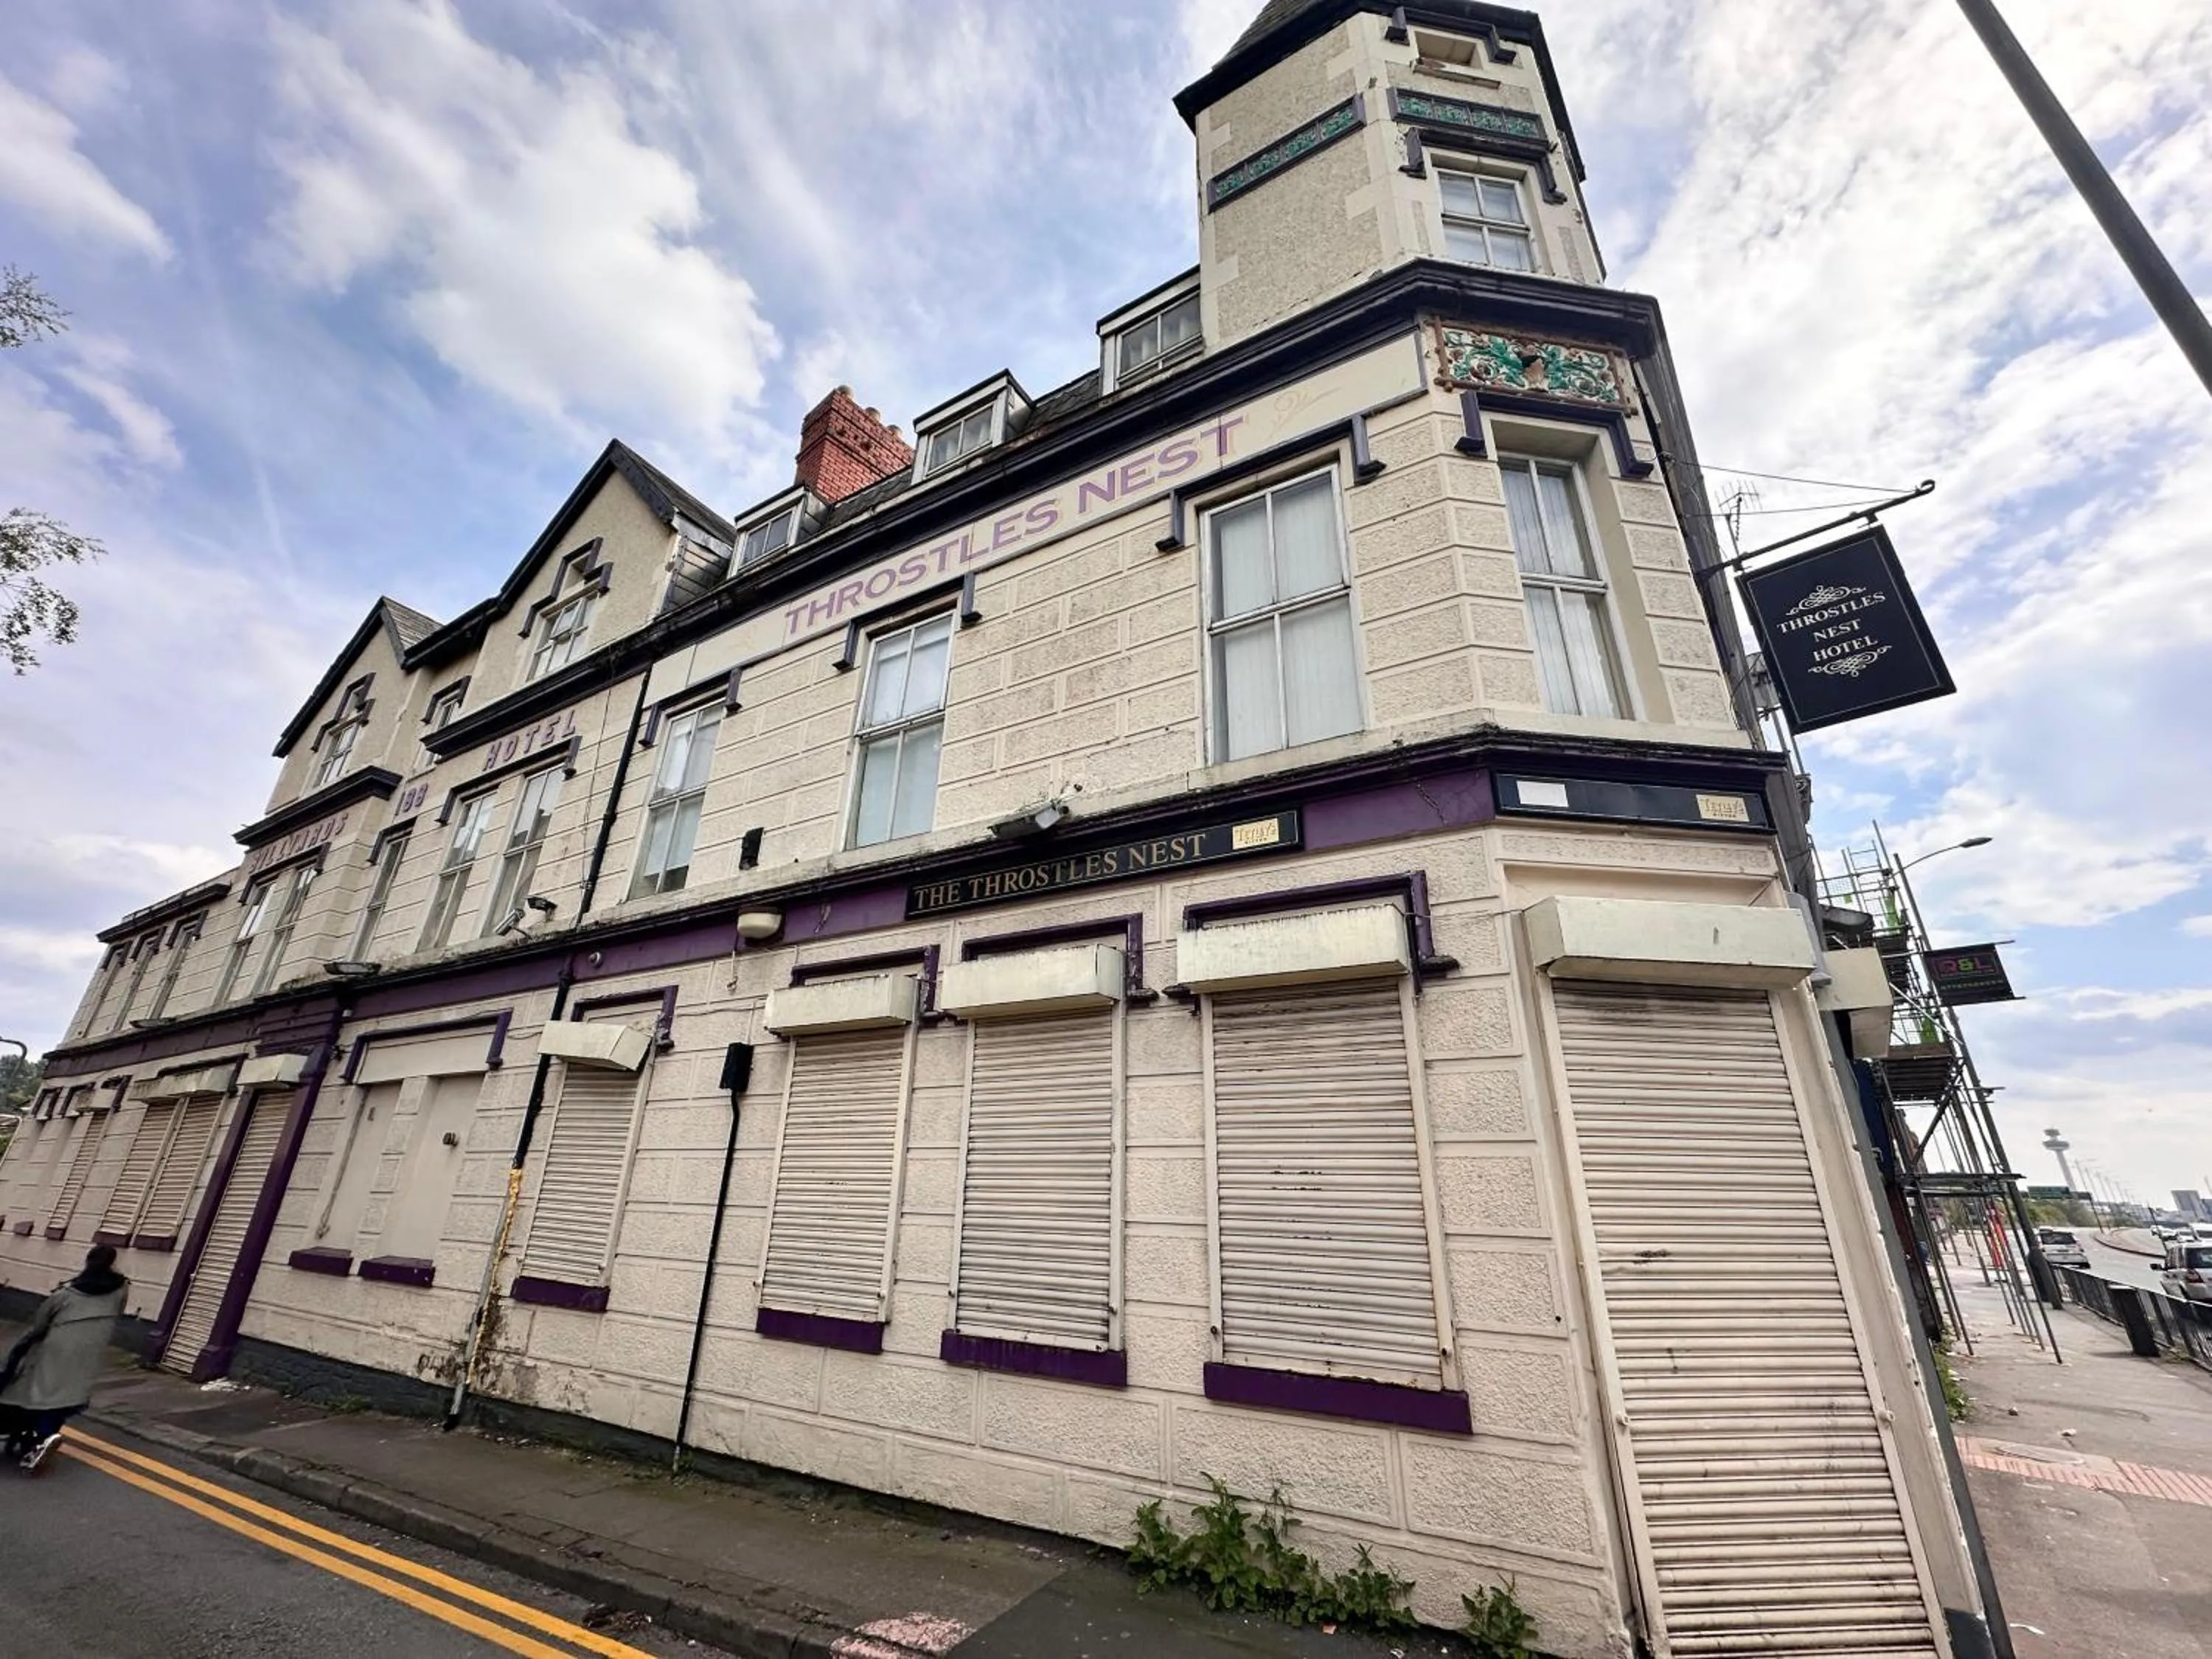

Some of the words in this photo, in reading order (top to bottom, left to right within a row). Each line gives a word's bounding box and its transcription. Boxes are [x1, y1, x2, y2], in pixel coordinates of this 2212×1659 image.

[785, 498, 1059, 636] THROSTLES
[1078, 413, 1248, 515] NEST
[1777, 591, 1886, 633] THROSTLES
[1813, 619, 1861, 642] NEST
[1813, 635, 1878, 661] HOTEL
[481, 709, 577, 772] HOTEL
[914, 882, 960, 910] THE
[968, 852, 1119, 899] THROSTLES
[1128, 833, 1206, 869] NEST
